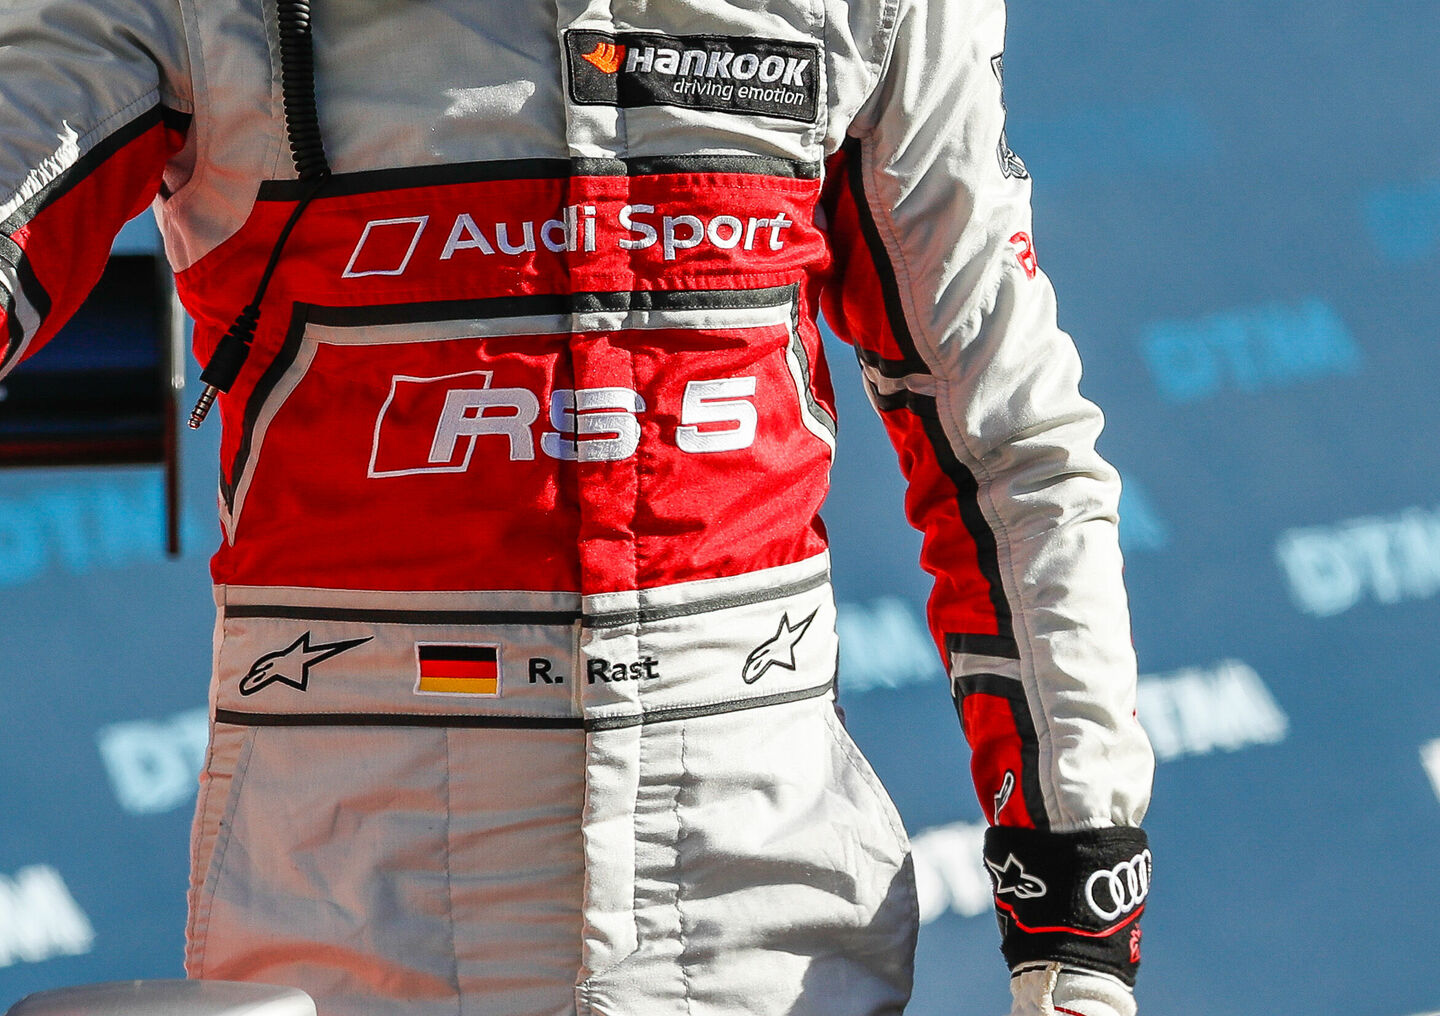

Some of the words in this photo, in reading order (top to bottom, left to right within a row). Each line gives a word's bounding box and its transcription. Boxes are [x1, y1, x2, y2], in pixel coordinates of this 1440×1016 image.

[625, 46, 810, 87] Hankook
[672, 80, 732, 101] driving
[737, 86, 805, 107] emotion
[440, 204, 596, 260] Audi
[618, 203, 792, 262] Sport
[428, 387, 644, 464] RS
[675, 377, 758, 455] 5
[527, 658, 564, 684] R.
[587, 656, 660, 684] Rast
